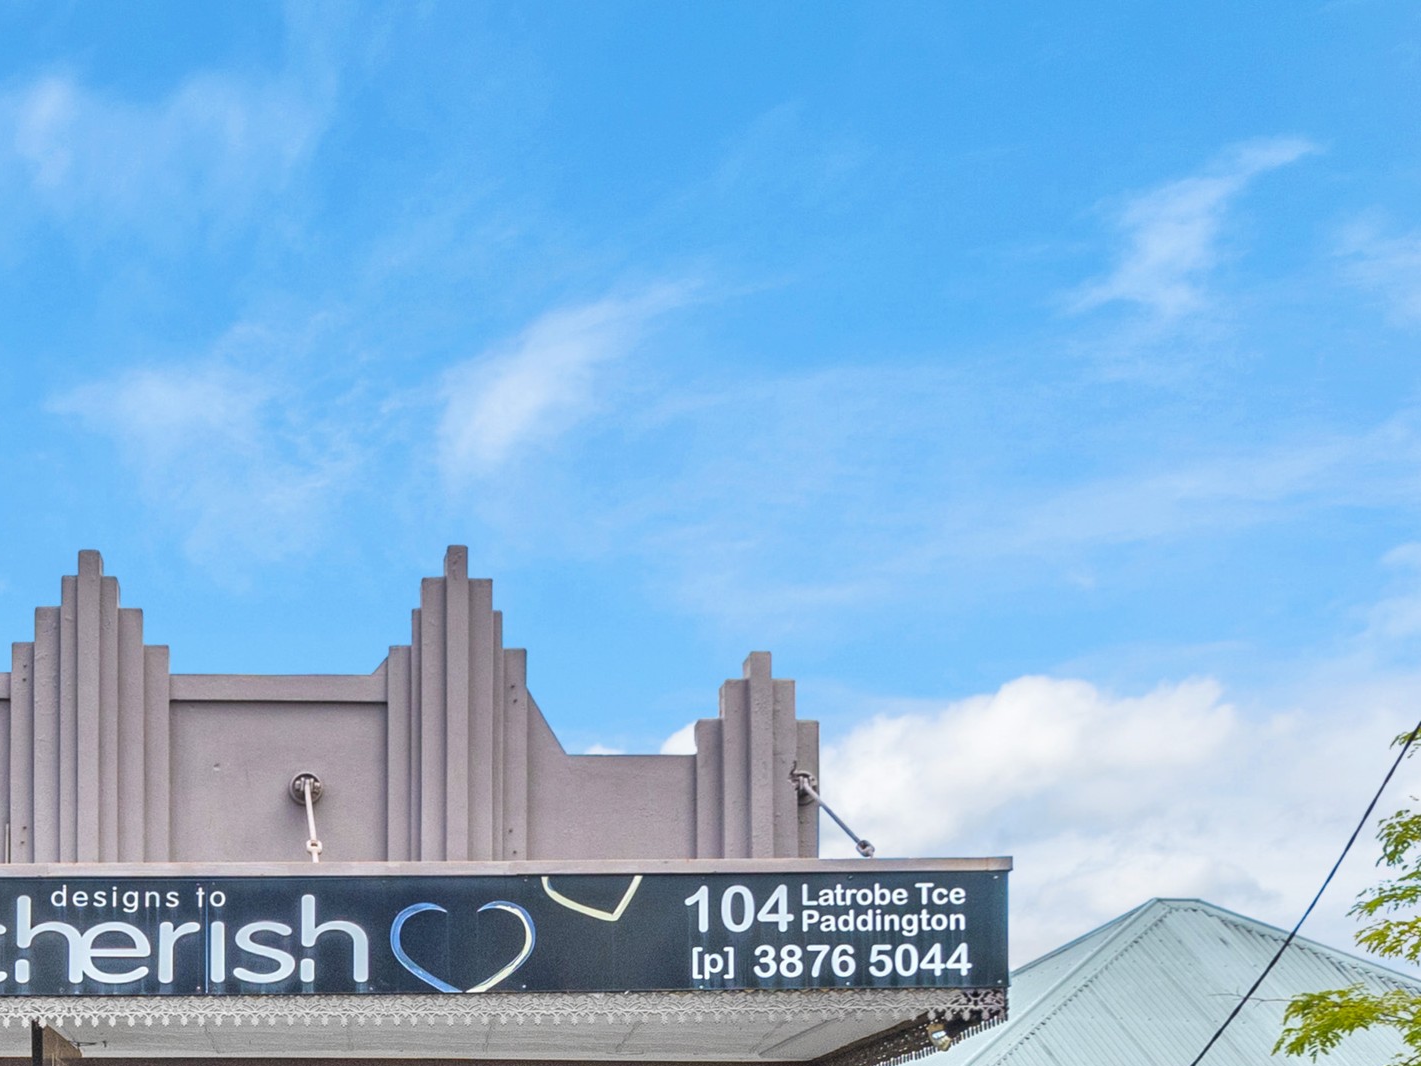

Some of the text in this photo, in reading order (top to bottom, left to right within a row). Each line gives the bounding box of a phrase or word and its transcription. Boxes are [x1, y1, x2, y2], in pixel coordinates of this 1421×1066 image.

[50, 884, 226, 913] designs to
[684, 882, 966, 933] 104 Latrobe Tce
[801, 908, 966, 937] Paddington
[691, 942, 973, 980] [p] 3876 5044
